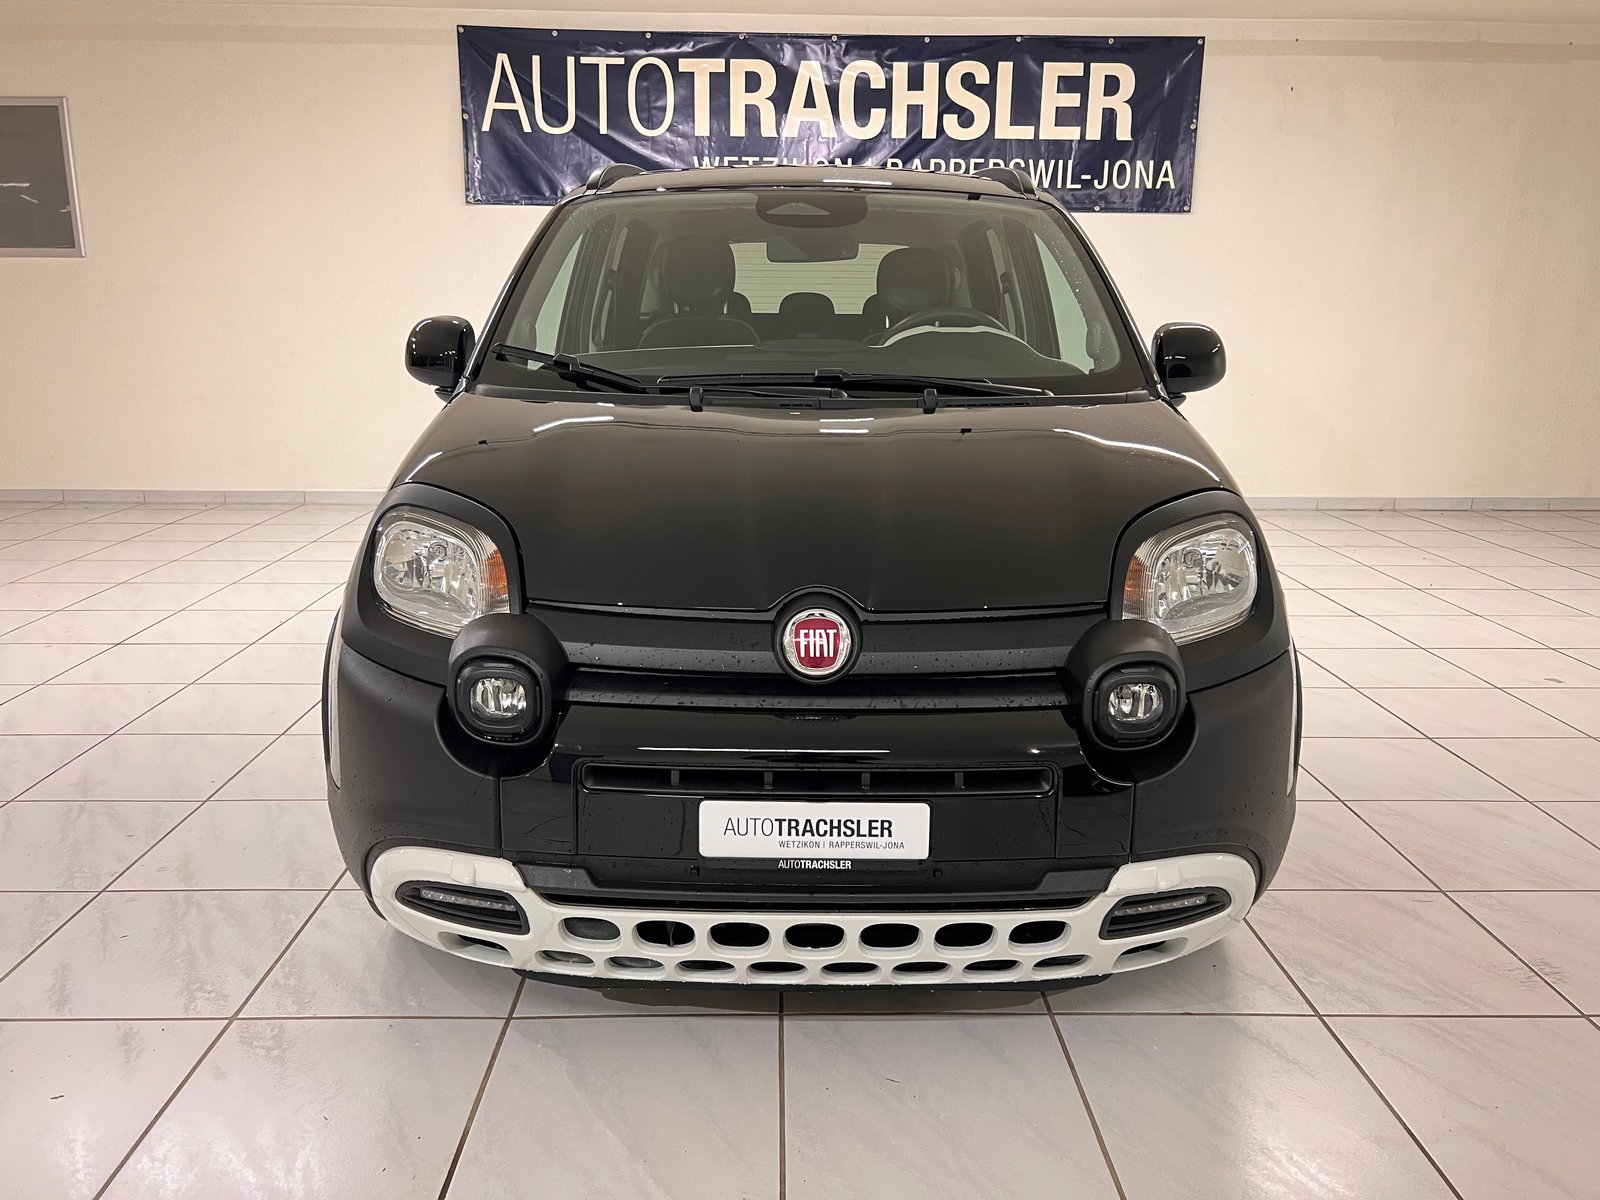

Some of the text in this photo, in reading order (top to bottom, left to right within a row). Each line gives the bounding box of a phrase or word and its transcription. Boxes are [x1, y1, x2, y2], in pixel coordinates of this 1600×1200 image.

[481, 52, 1137, 141] AUTOTRACHSLER
[799, 628, 838, 658] FIAT
[723, 817, 893, 838] AUTOTRACHSLER
[778, 840, 821, 849] WETZIKON
[828, 841, 905, 850] RAPPERSWIL-JONA
[778, 859, 852, 870] AUTOTRACHSLER
